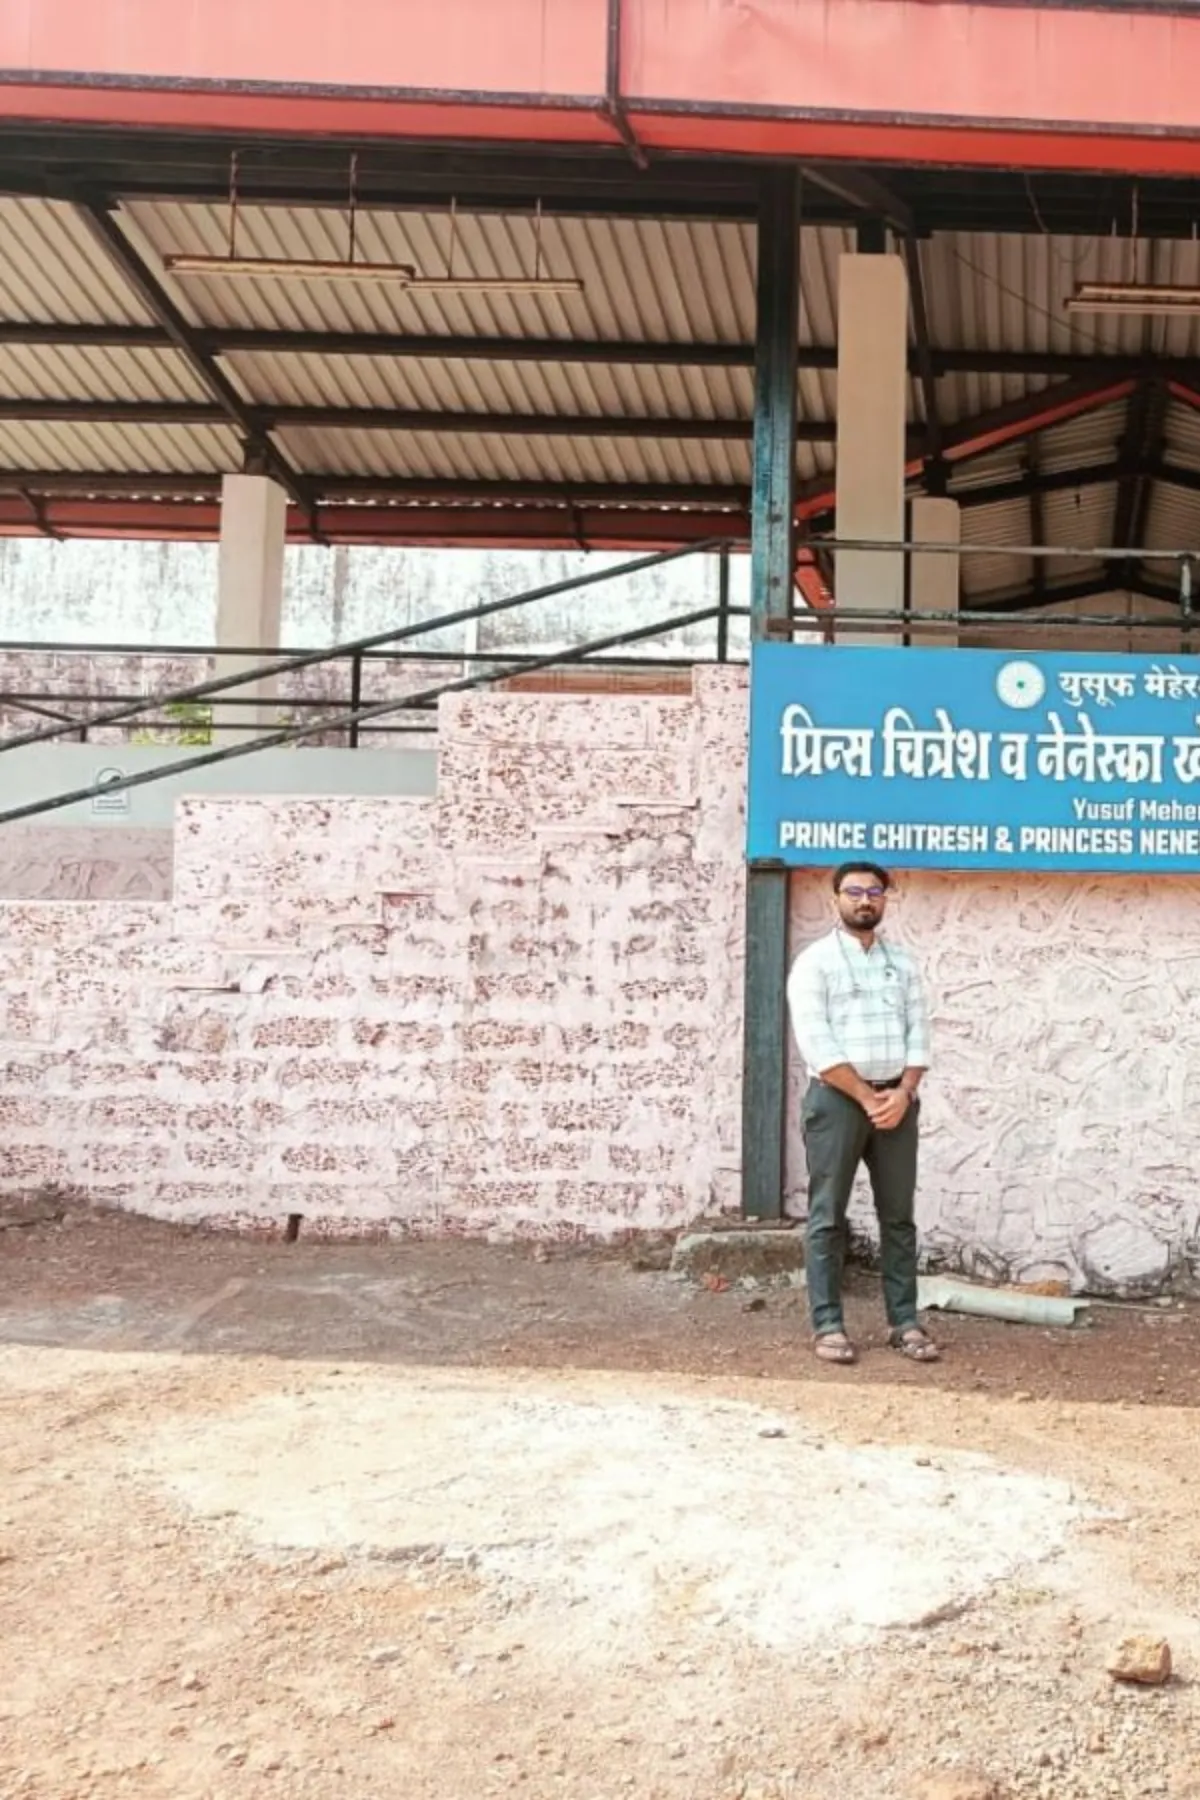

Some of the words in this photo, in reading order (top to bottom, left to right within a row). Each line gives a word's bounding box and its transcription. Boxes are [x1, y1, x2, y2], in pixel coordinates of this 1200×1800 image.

[1059, 671, 1136, 707] युसूफ
[779, 703, 874, 778] प्रिन्स
[881, 707, 991, 781] चित्रेश
[999, 732, 1029, 781] व
[1035, 710, 1164, 784] नेनेस्का
[1073, 797, 1135, 821] Yusuf
[779, 820, 866, 849] PRINCE
[872, 822, 989, 853] CHITRESH
[994, 826, 1014, 853] &
[1020, 826, 1133, 855] PRINCESS
